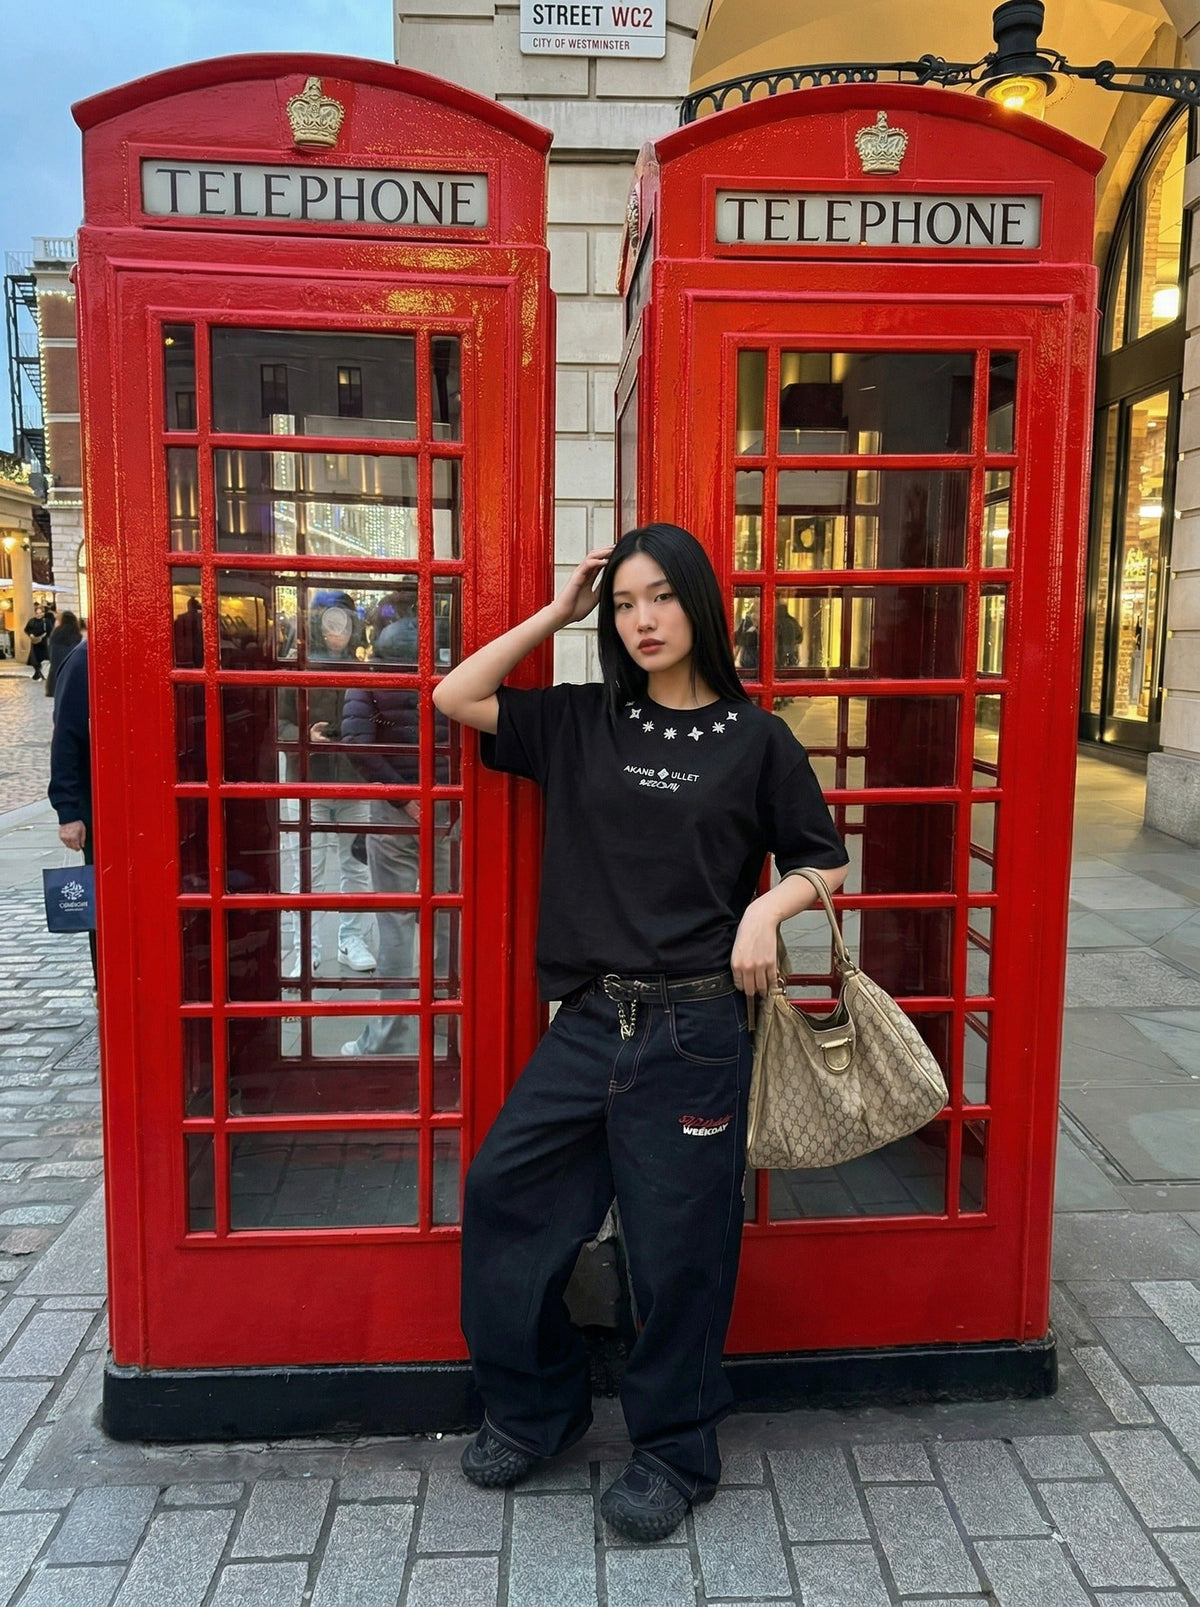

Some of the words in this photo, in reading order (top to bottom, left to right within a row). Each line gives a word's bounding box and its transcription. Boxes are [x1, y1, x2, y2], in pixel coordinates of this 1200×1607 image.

[533, 4, 603, 26] STREET
[612, 6, 653, 28] WC2
[533, 38, 552, 48] CITY
[555, 39, 566, 49] OF
[568, 39, 630, 50] WESTMINSTER
[155, 168, 477, 225] TELEPHONE
[725, 198, 1026, 246] TELEPHONE
[671, 771, 700, 782] ULLET
